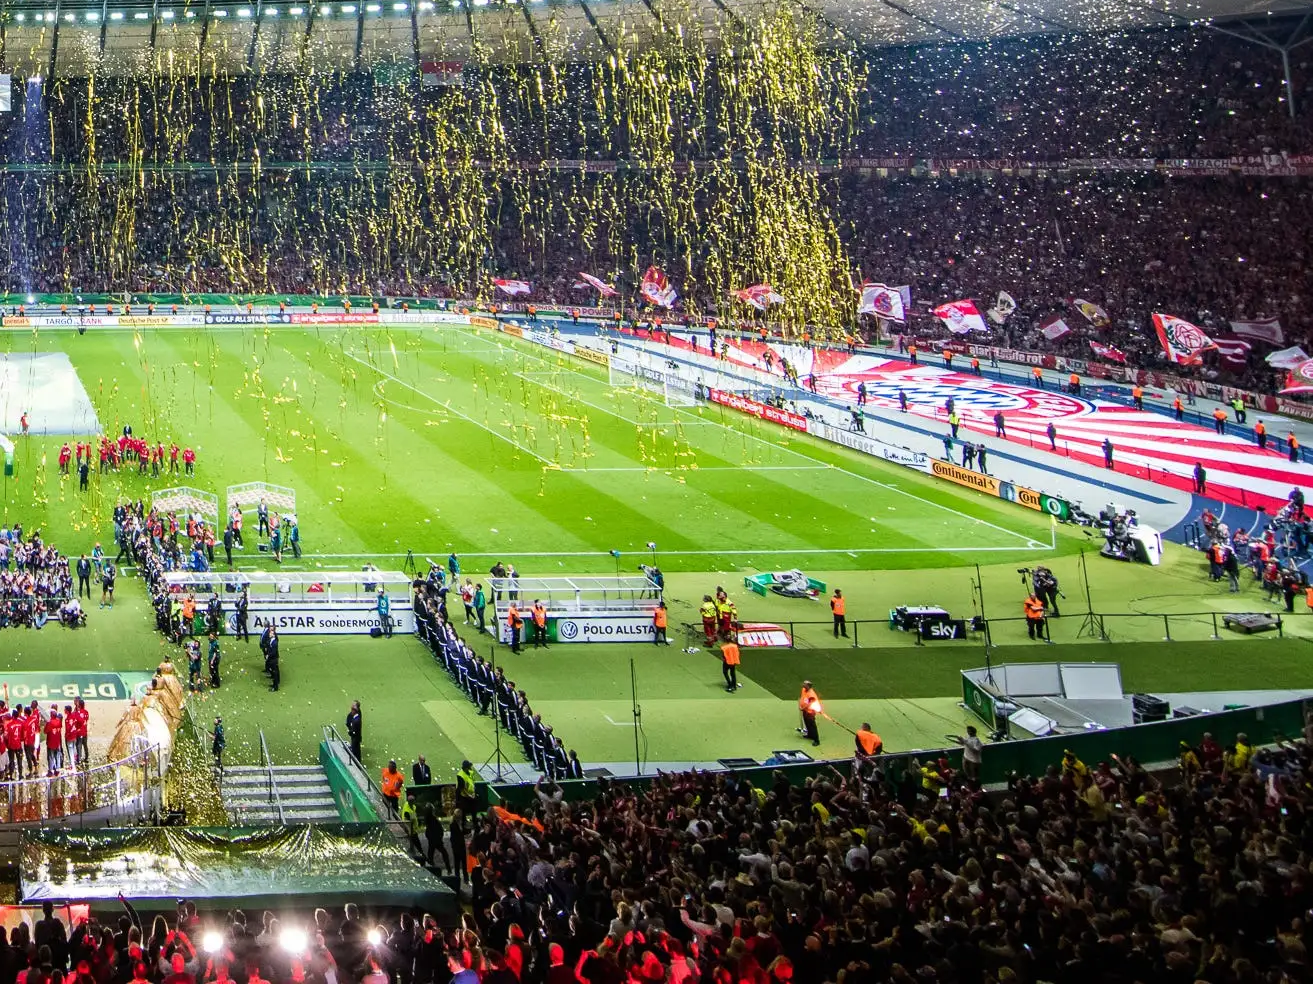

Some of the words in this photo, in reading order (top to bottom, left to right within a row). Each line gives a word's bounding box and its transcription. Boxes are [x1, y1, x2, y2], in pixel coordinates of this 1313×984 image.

[766, 408, 807, 430] strauss
[824, 424, 875, 454] Bitburger
[932, 459, 988, 489] Continental
[584, 625, 613, 635] POLO
[930, 621, 957, 639] sky
